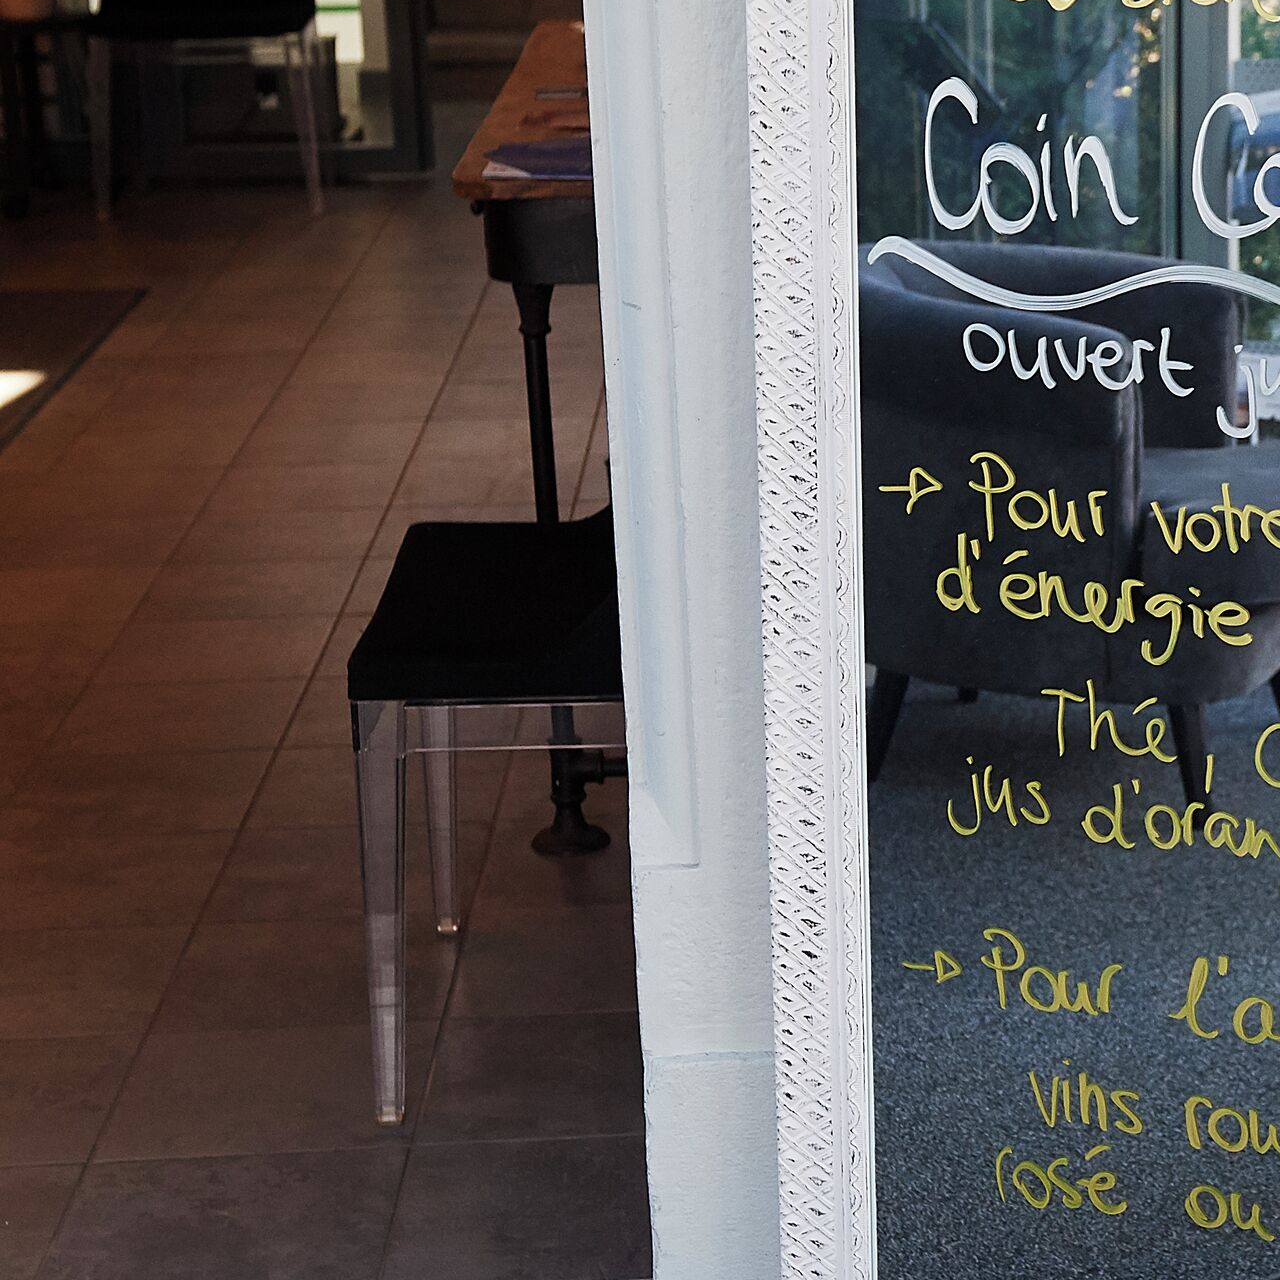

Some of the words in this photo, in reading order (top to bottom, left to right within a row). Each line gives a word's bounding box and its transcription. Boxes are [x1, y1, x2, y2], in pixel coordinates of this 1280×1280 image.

[924, 77, 1139, 235] Coin
[963, 323, 1195, 397] ouvert
[968, 452, 1108, 543] Pour
[936, 532, 1254, 665] d'énergie
[946, 756, 1051, 836] jus
[981, 928, 1122, 1014] Pour
[1027, 1060, 1144, 1136] vins
[994, 1145, 1128, 1214] rosé
[1184, 1185, 1276, 1243] ou
